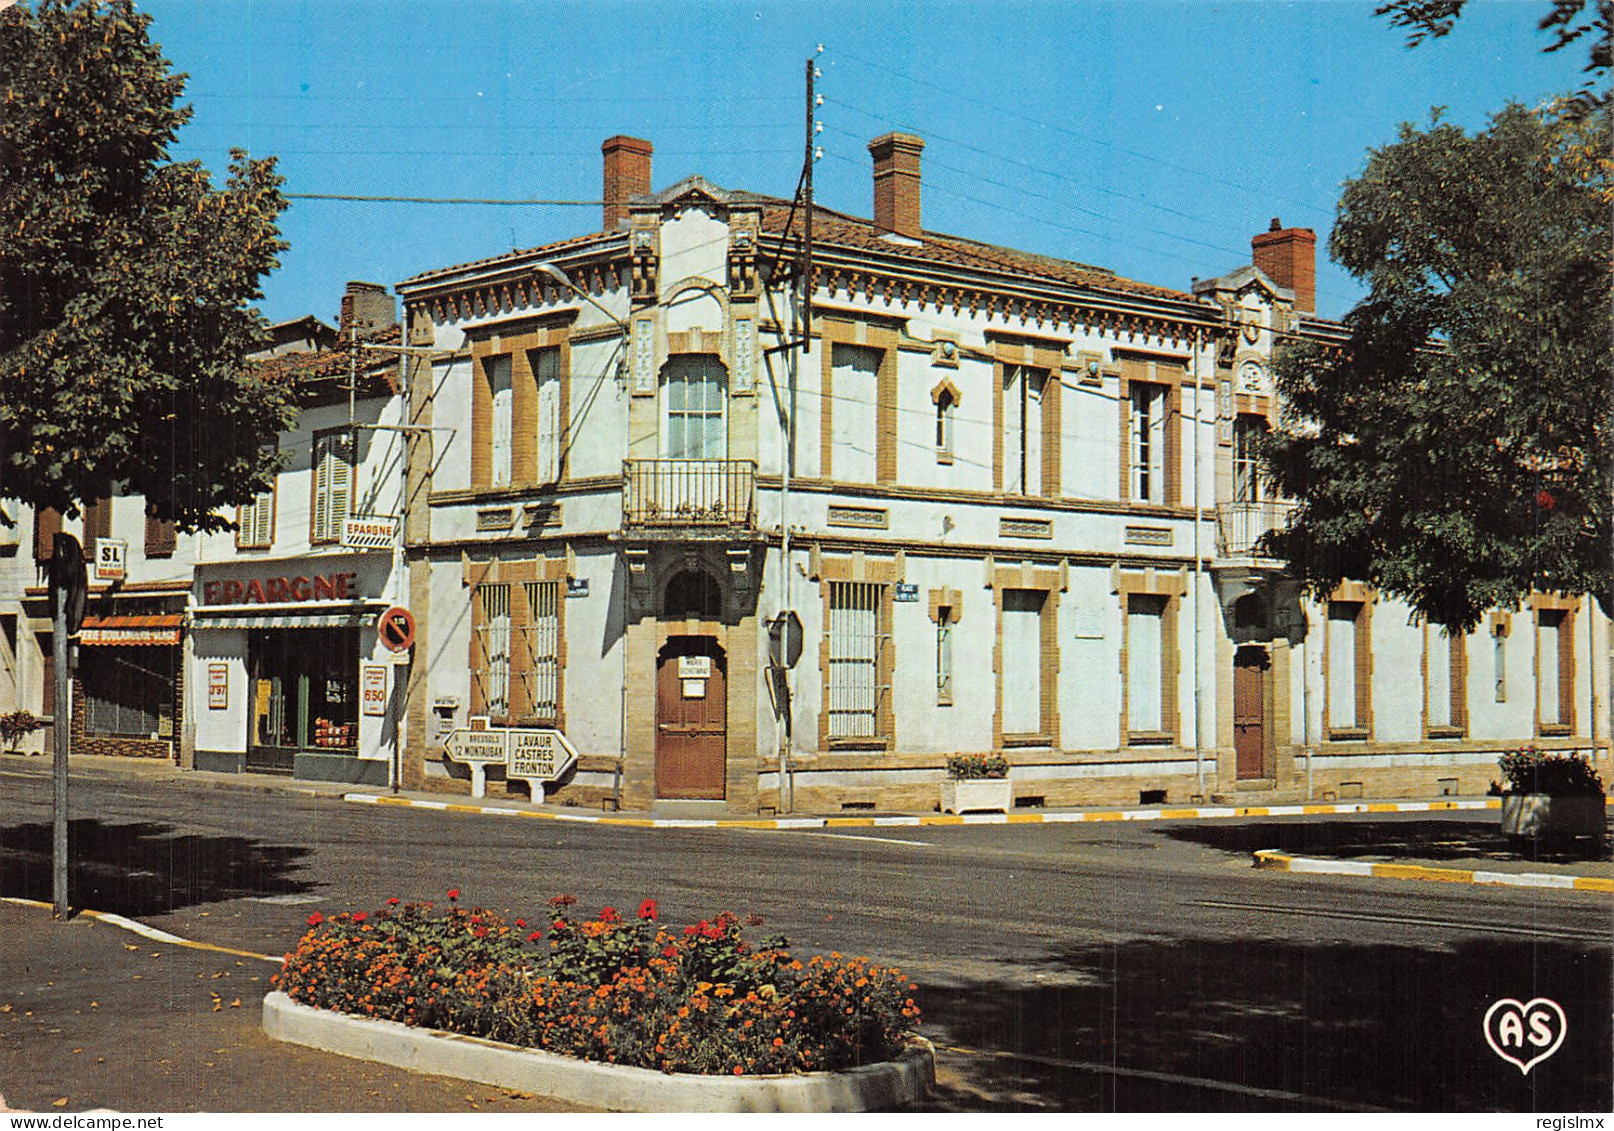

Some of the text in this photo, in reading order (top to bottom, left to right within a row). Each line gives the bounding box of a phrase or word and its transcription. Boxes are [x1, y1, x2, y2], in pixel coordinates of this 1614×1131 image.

[347, 523, 393, 537] EPARGNE
[203, 572, 358, 606] EPARGNE
[469, 734, 500, 743] BRESSOLS
[518, 735, 552, 748] LAVAUR
[455, 746, 503, 758] 12 MONTAUBAN
[515, 748, 554, 761] CASTRES
[515, 762, 554, 774] FRONTON
